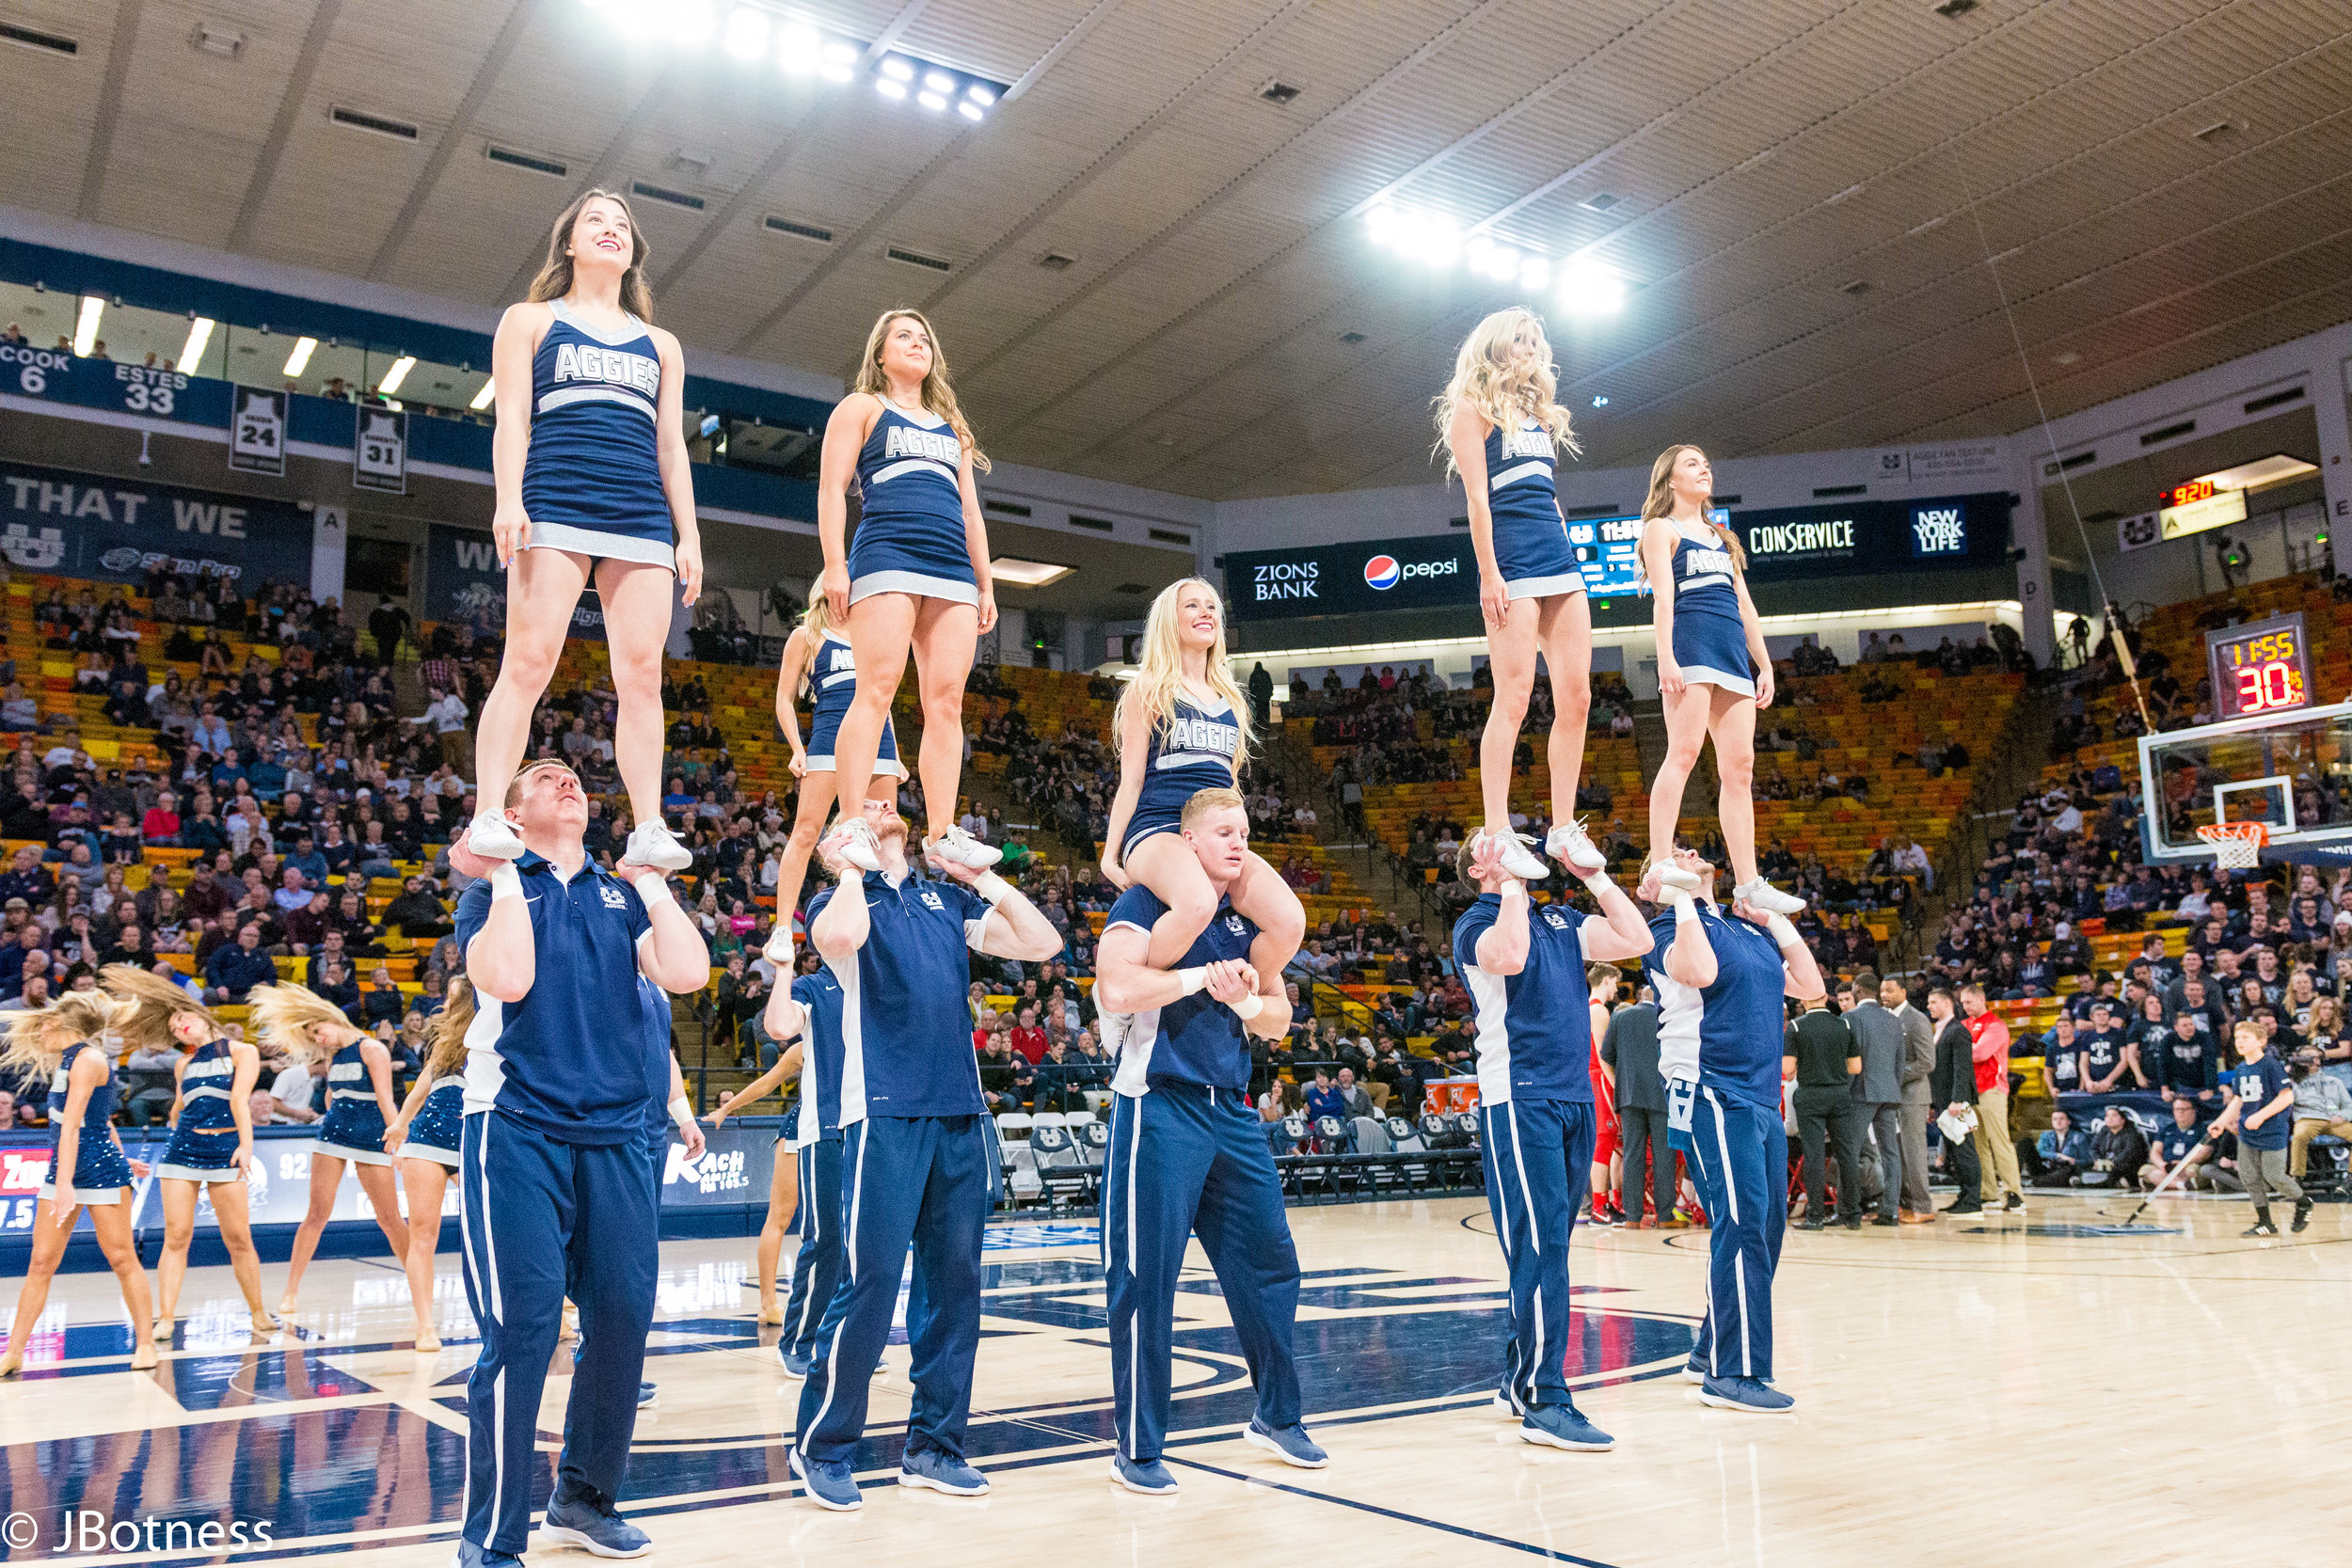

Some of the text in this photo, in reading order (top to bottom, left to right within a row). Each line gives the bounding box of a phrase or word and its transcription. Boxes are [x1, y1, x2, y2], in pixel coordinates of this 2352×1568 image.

[0, 345, 69, 372] COOK
[555, 343, 660, 397] AGGIES
[21, 365, 46, 393] 6
[115, 365, 187, 390] ESTES
[125, 383, 174, 414] 33
[242, 425, 275, 447] 24
[367, 445, 393, 465] 31
[6, 477, 247, 539] THAT WE
[1917, 509, 1958, 527] NEW
[323, 513, 340, 530] A
[1913, 521, 1964, 540] YORK
[1921, 535, 1961, 552] LIFE
[1254, 562, 1319, 582] ZIONS
[1403, 558, 1458, 581] pepsi
[1255, 580, 1319, 601] BANK
[2233, 632, 2294, 665] 11:55
[2237, 661, 2292, 712] 30
[1171, 718, 1240, 759] AGGIE
